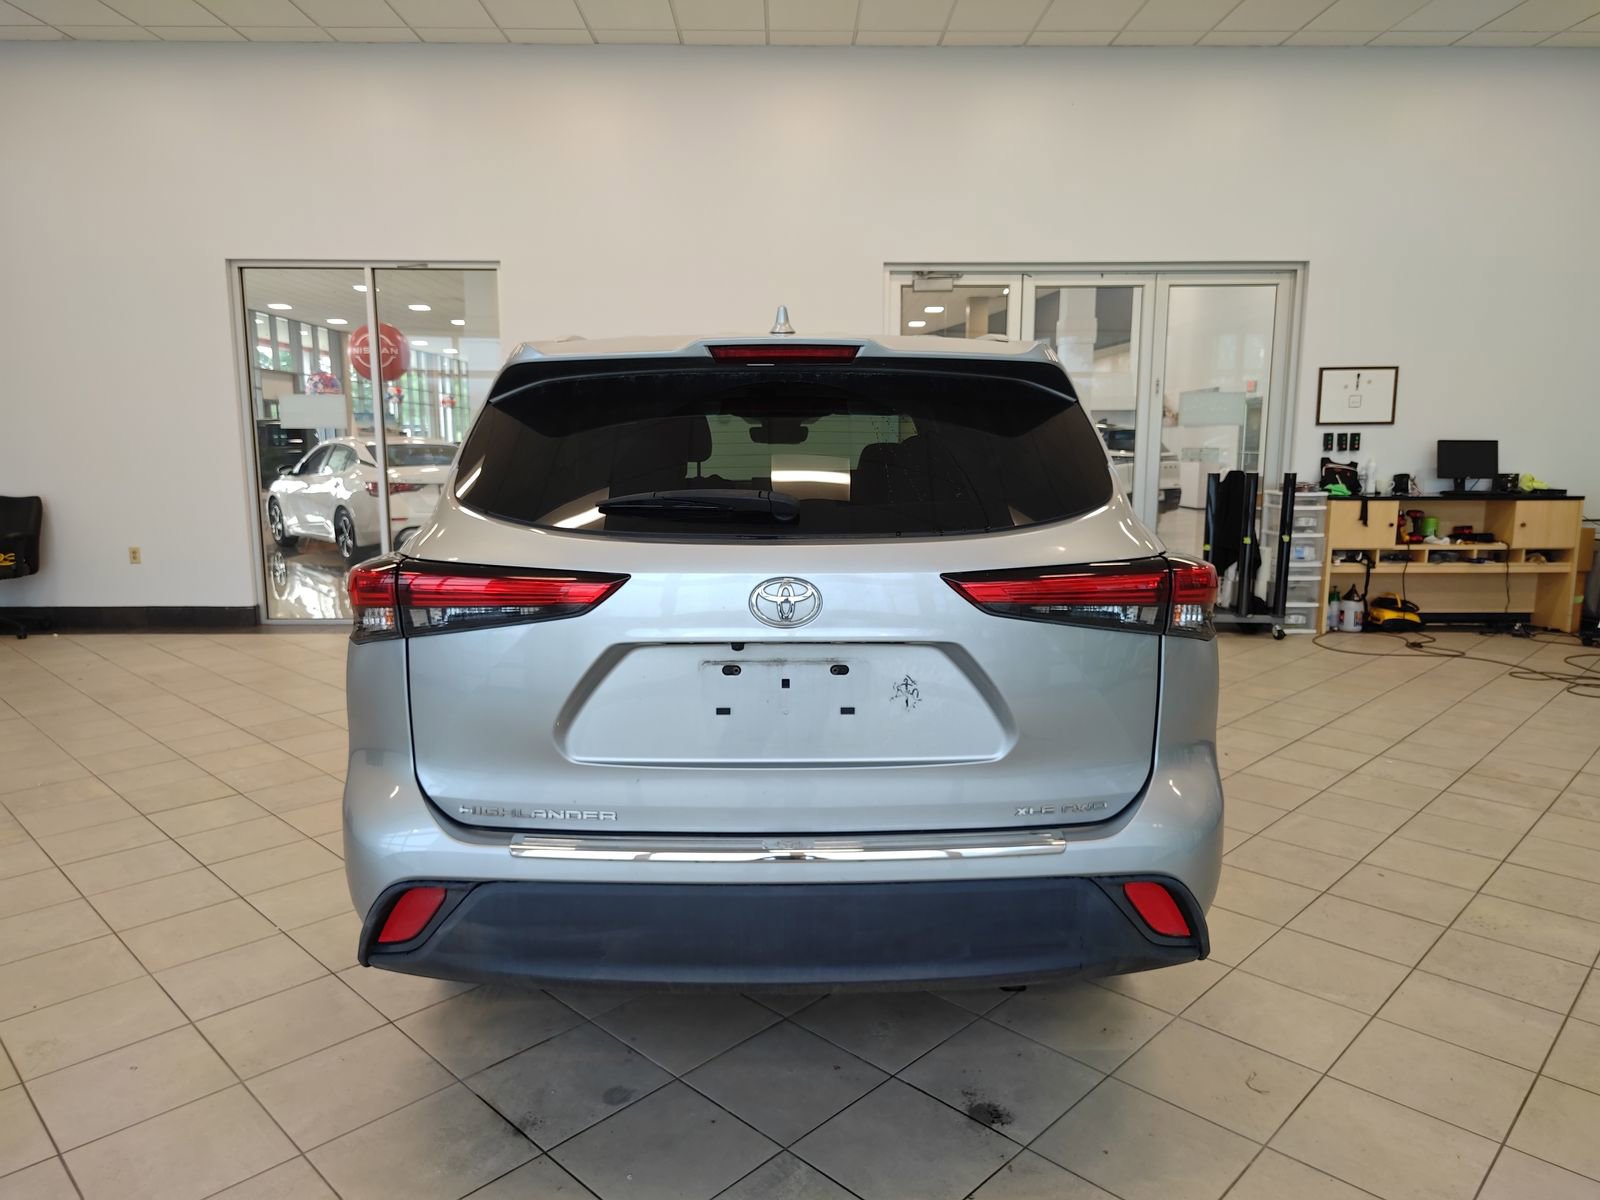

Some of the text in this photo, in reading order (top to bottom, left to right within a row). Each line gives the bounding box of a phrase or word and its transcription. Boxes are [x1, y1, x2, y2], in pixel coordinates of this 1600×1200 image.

[351, 347, 399, 355] NISAN
[459, 804, 618, 822] HIGHLANDER
[1015, 804, 1056, 816] XLE
